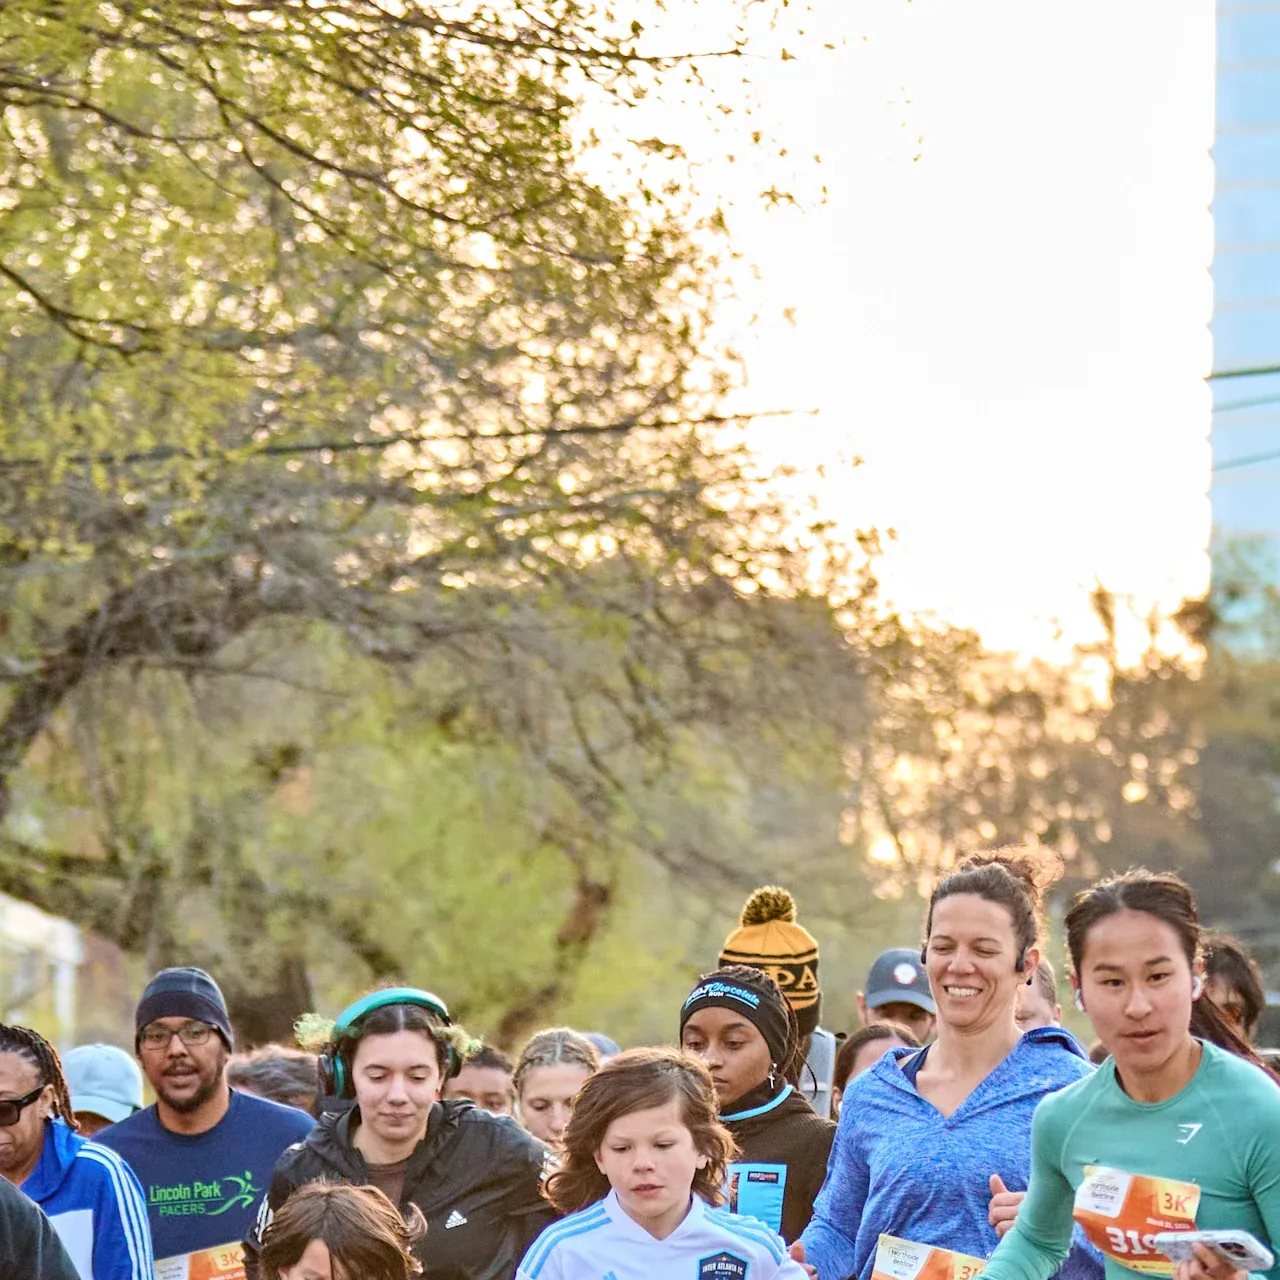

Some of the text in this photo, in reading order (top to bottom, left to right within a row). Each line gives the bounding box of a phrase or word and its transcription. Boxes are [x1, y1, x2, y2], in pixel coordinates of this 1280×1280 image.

[708, 981, 760, 1005] Chocolate
[148, 1181, 222, 1203] Lincoln Park
[159, 1203, 206, 1216] PACERS
[1164, 1192, 1192, 1213] 3K
[220, 1250, 243, 1268] 3K
[890, 1249, 920, 1262] Northside
[892, 1258, 914, 1268] Beltline
[717, 1262, 737, 1273] ATLANTA
